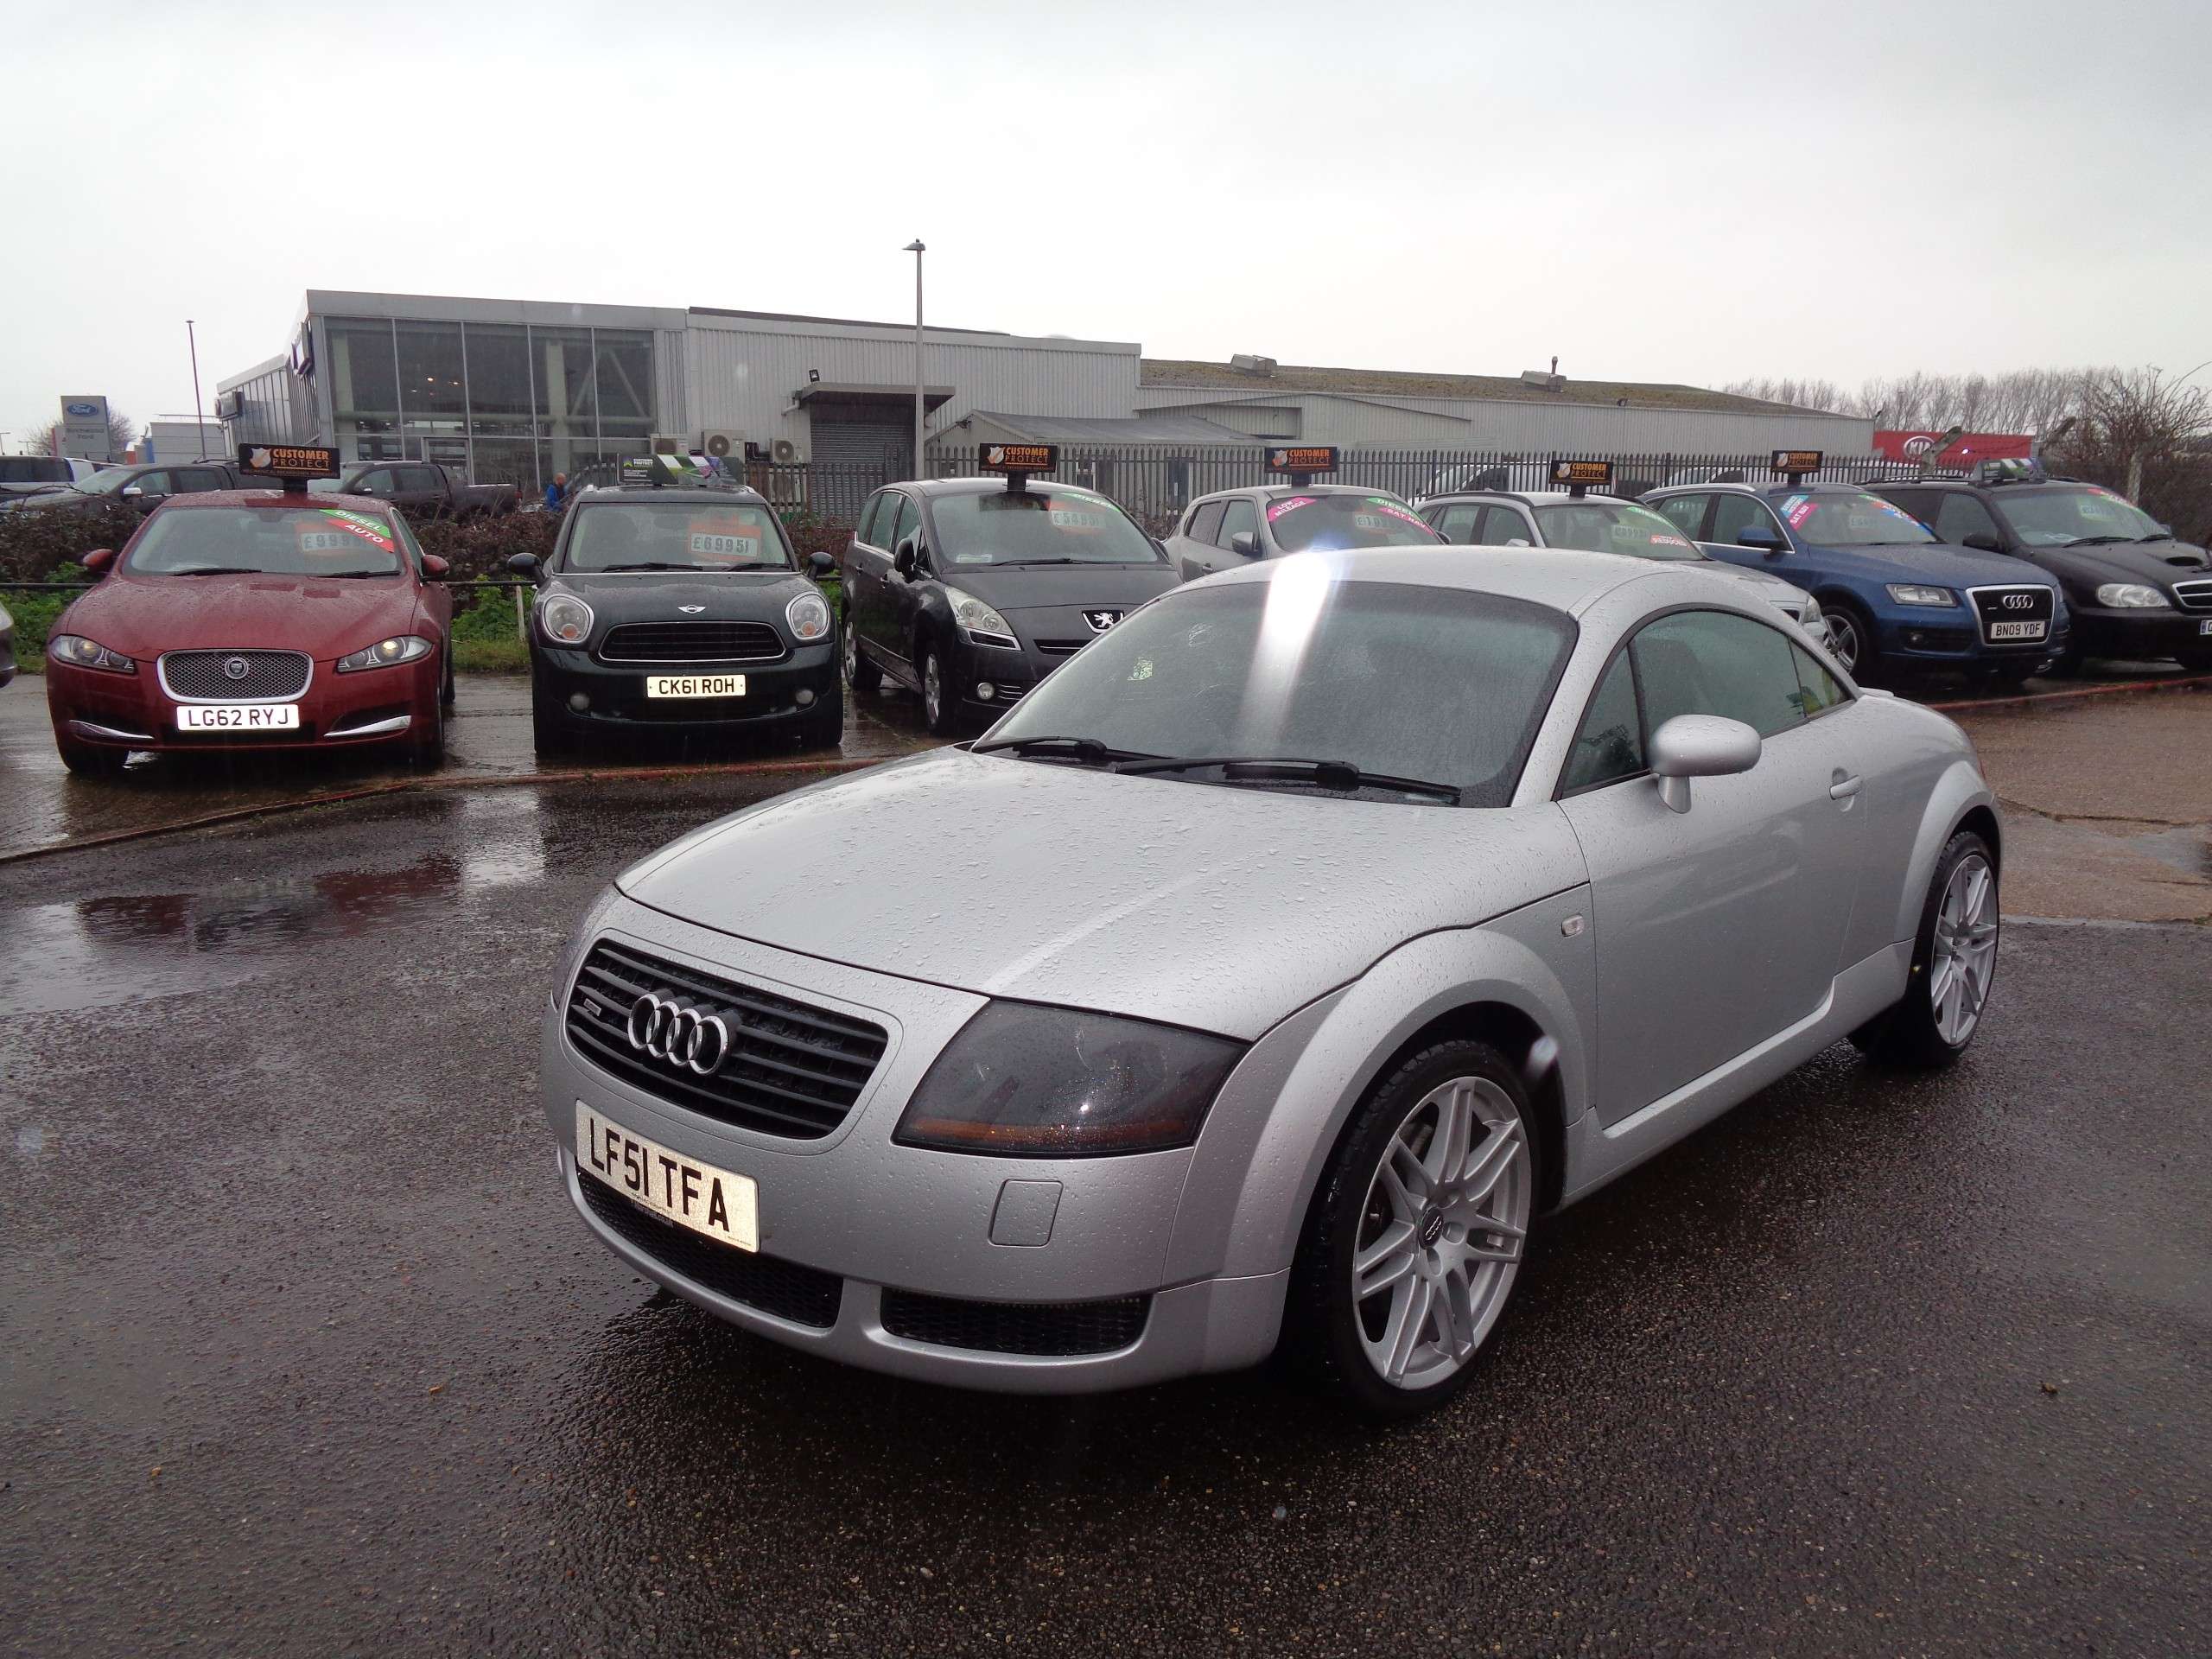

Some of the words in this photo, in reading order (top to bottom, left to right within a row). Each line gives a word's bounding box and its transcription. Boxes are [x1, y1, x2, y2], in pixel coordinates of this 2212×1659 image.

[272, 449, 328, 460] CUSTOMER
[272, 459, 330, 467] PROTECT
[1274, 500, 1306, 517] MILEAGE
[1277, 501, 1293, 510] LOW
[334, 511, 381, 532] DIESEL
[345, 524, 384, 543] AUTO
[1995, 625, 2021, 637] BN09
[2024, 624, 2041, 635] YDF
[659, 679, 696, 694] CK61
[702, 678, 734, 693] ROH
[188, 709, 241, 727] LG62
[249, 709, 287, 725] RYJ
[590, 1117, 650, 1198] LF51
[658, 1154, 730, 1233] TFA
